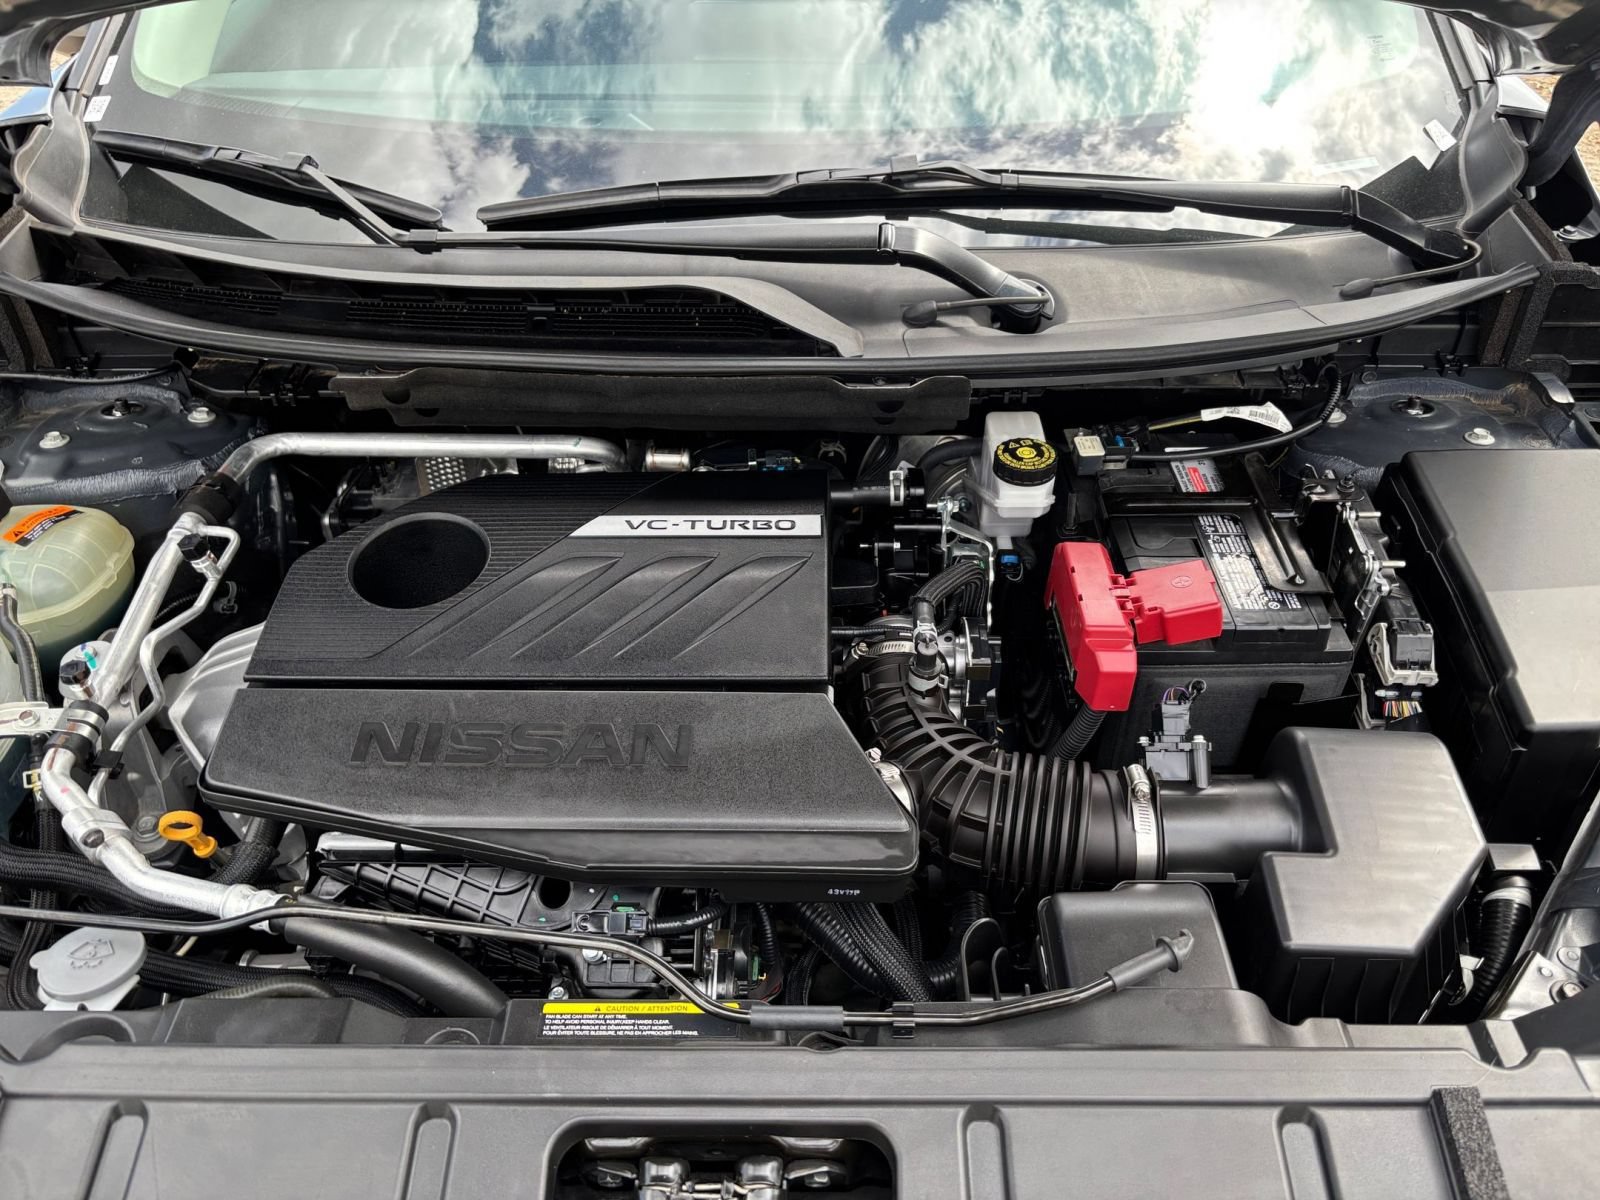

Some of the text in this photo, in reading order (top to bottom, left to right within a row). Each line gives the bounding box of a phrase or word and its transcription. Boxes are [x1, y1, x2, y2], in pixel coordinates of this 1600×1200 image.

[624, 519, 797, 531] VC-TURBO
[349, 721, 696, 768] NISSAN
[647, 1004, 688, 1012] ATTENTION
